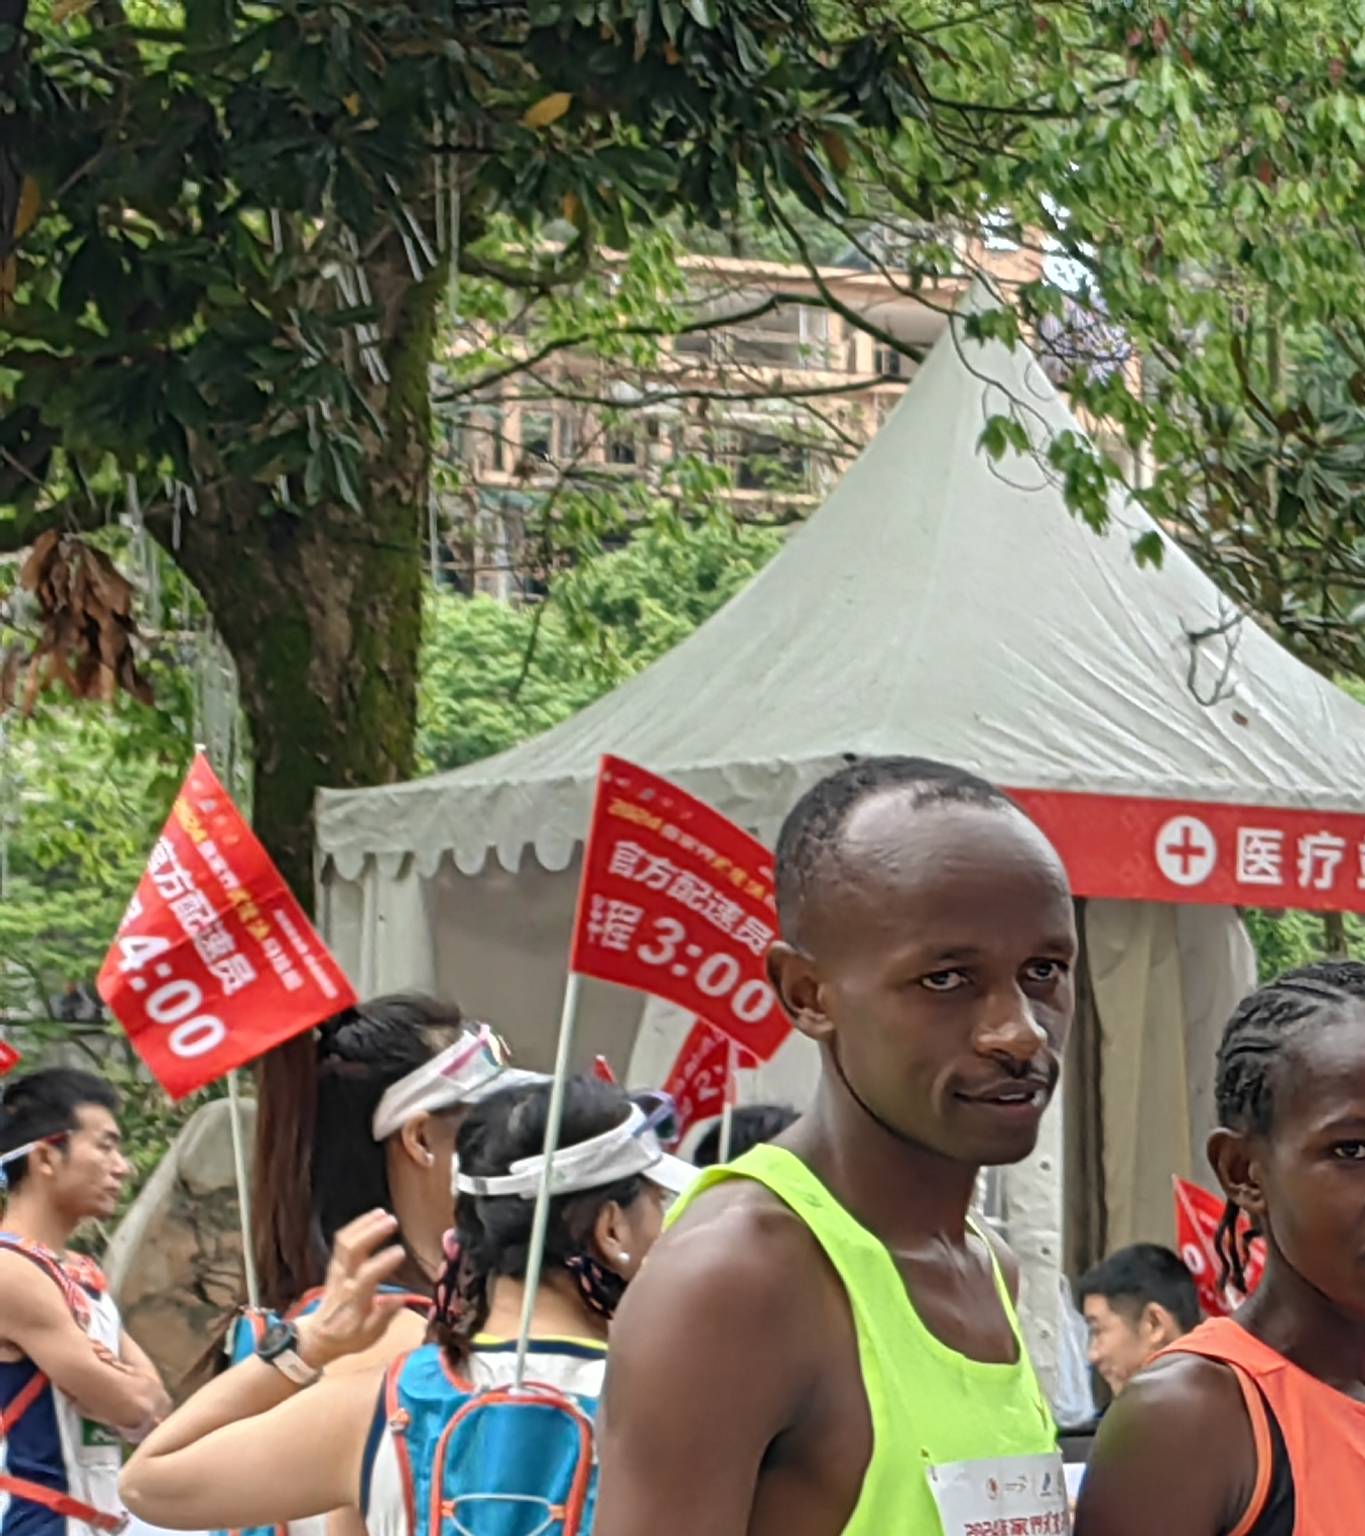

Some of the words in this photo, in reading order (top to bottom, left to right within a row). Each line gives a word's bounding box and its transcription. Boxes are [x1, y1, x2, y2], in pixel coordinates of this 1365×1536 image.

[607, 838, 777, 956] 官方配速员
[117, 936, 226, 1058] 4:00
[636, 916, 775, 1023] 3:00
